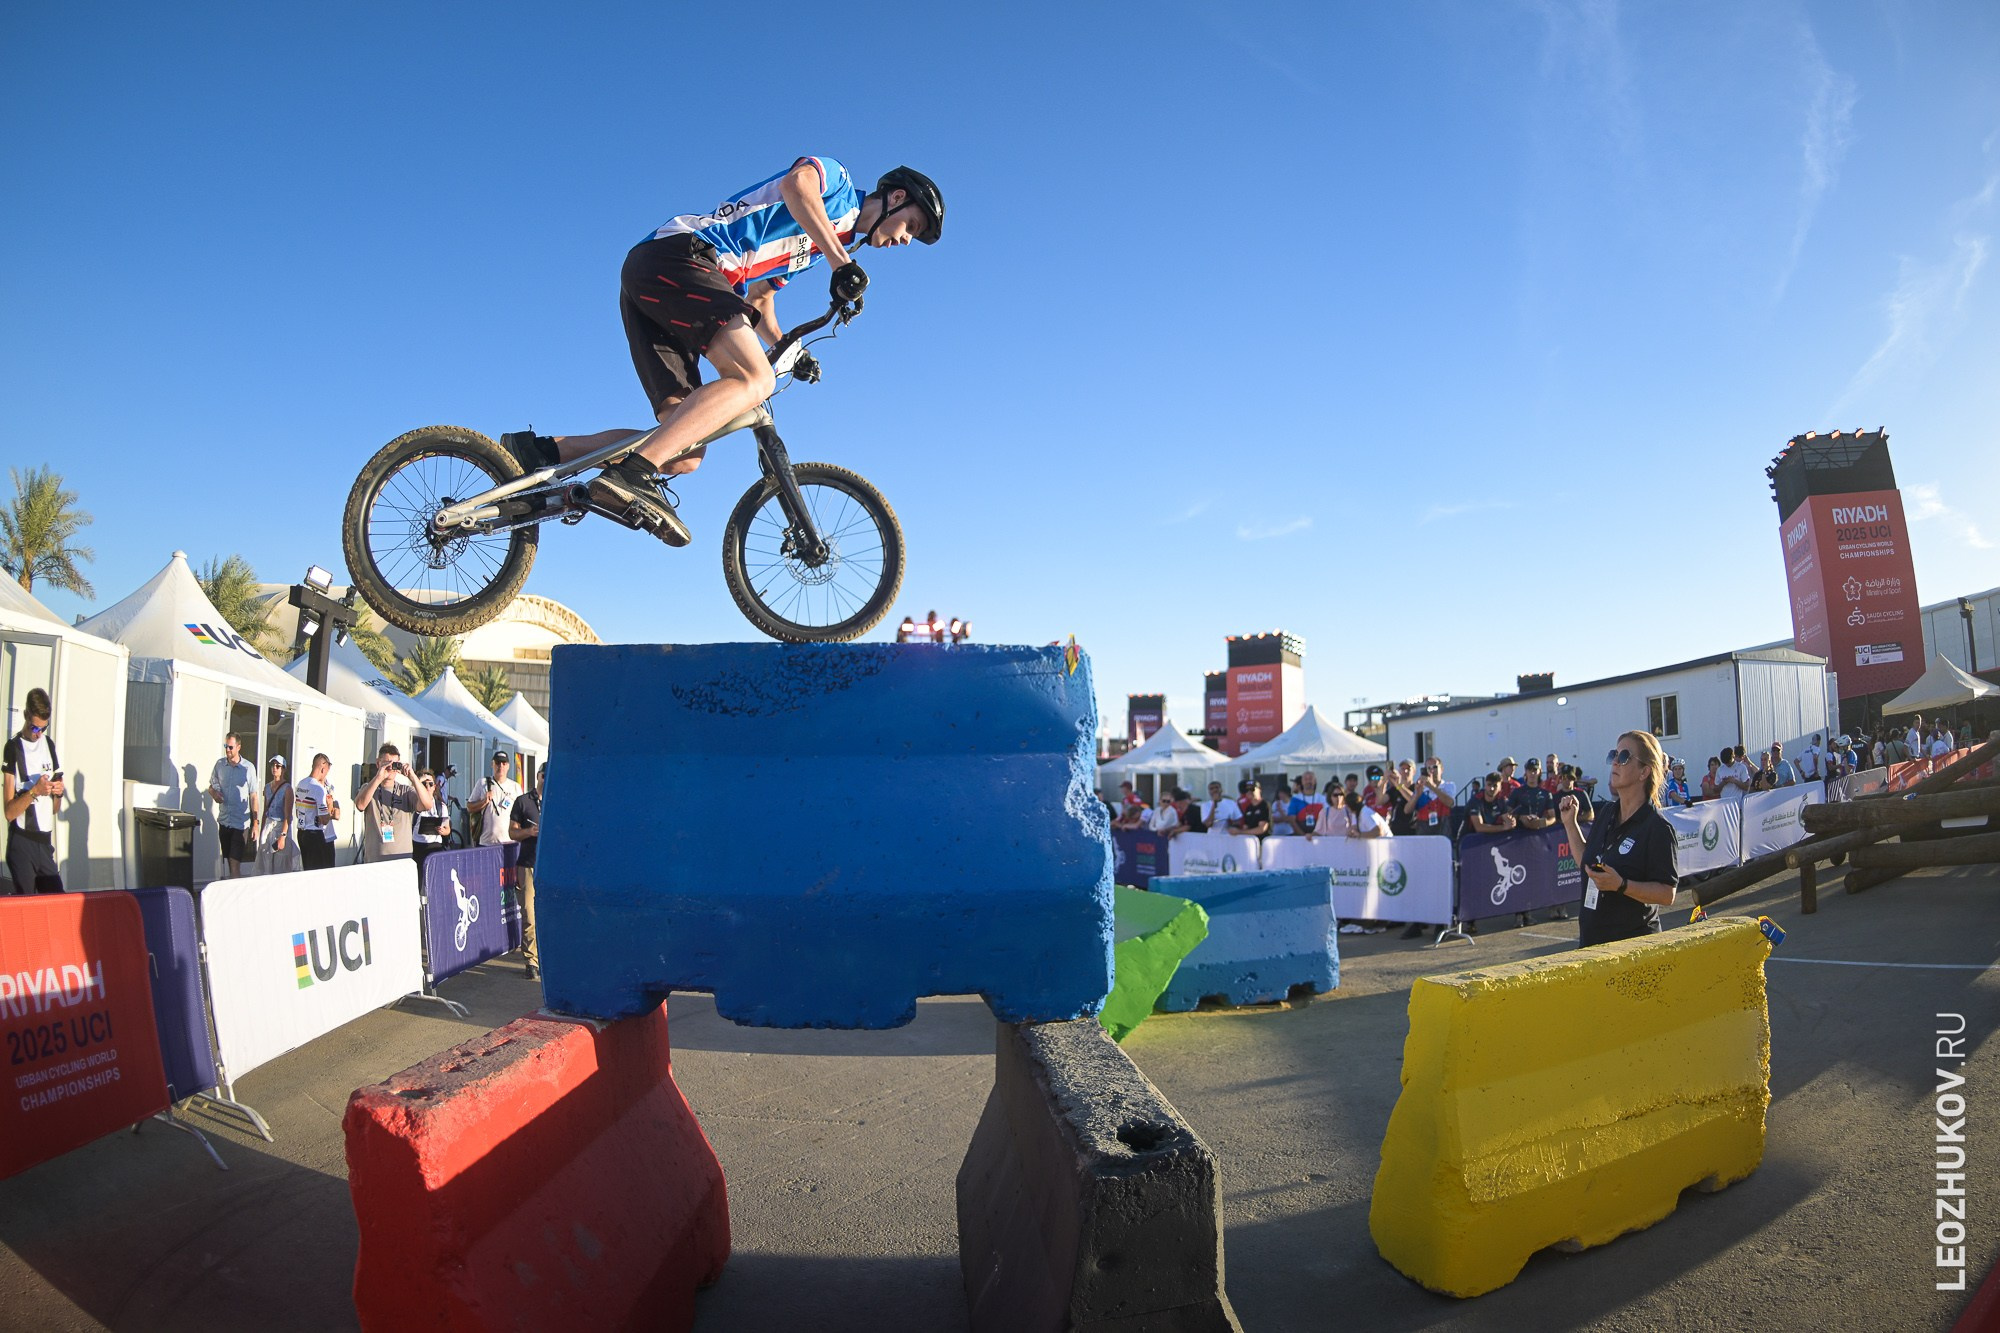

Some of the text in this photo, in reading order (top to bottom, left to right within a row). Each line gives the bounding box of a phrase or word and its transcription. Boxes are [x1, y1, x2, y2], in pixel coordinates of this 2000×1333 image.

[1832, 505, 1888, 525] RIYADH
[1836, 525, 1892, 541] 2025 UCI
[1840, 548, 1895, 560] CHAMPIONSHIPS
[200, 623, 266, 662] UC
[308, 917, 372, 982] UCI
[0, 960, 106, 1020] RIYADH
[7, 1010, 113, 1065] 2025 UCI
[16, 1049, 117, 1088] URBAN CYCLING WORLD
[21, 1067, 121, 1111] CHAMPIONSHIPS
